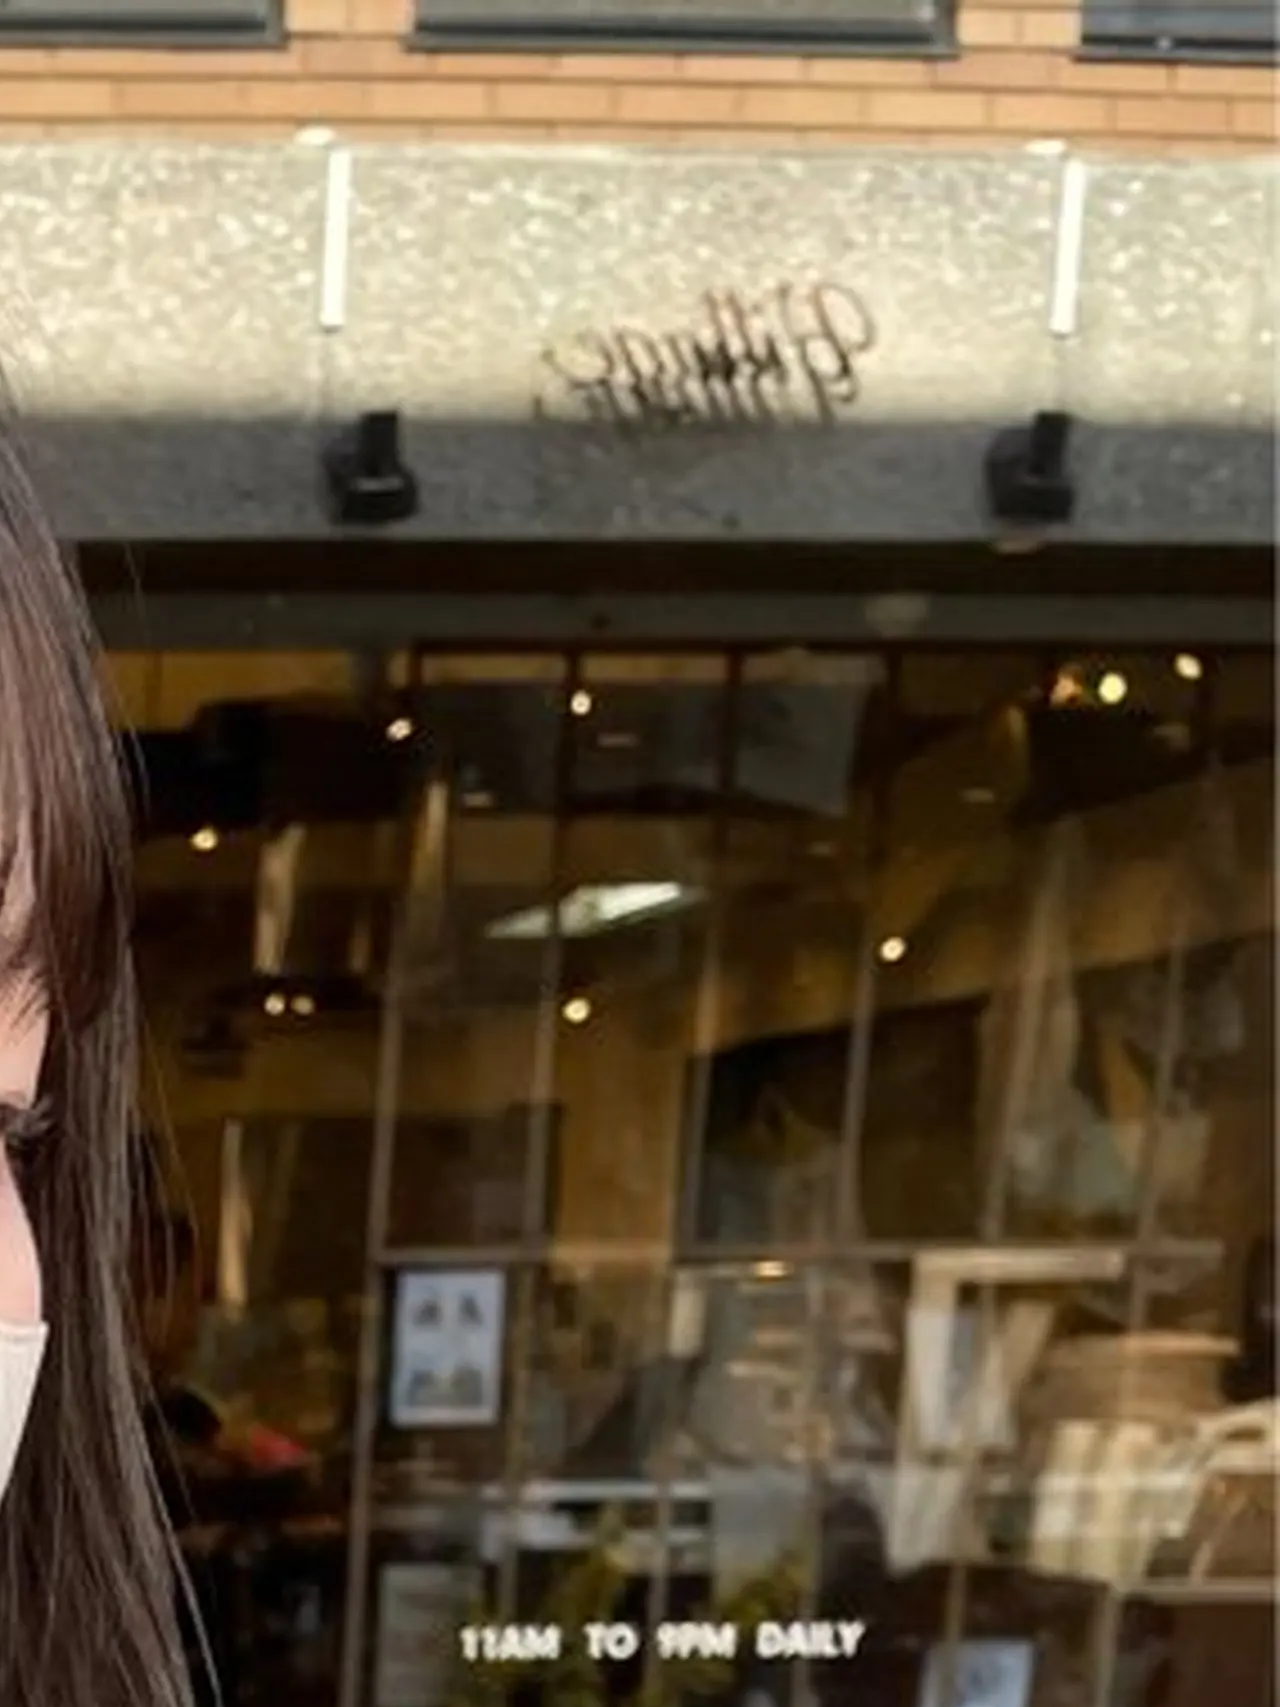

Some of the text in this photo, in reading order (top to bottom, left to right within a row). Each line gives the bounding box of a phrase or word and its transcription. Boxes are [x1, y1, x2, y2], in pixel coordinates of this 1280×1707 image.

[459, 1620, 866, 1661] 11AM TO 9PM DAILY
